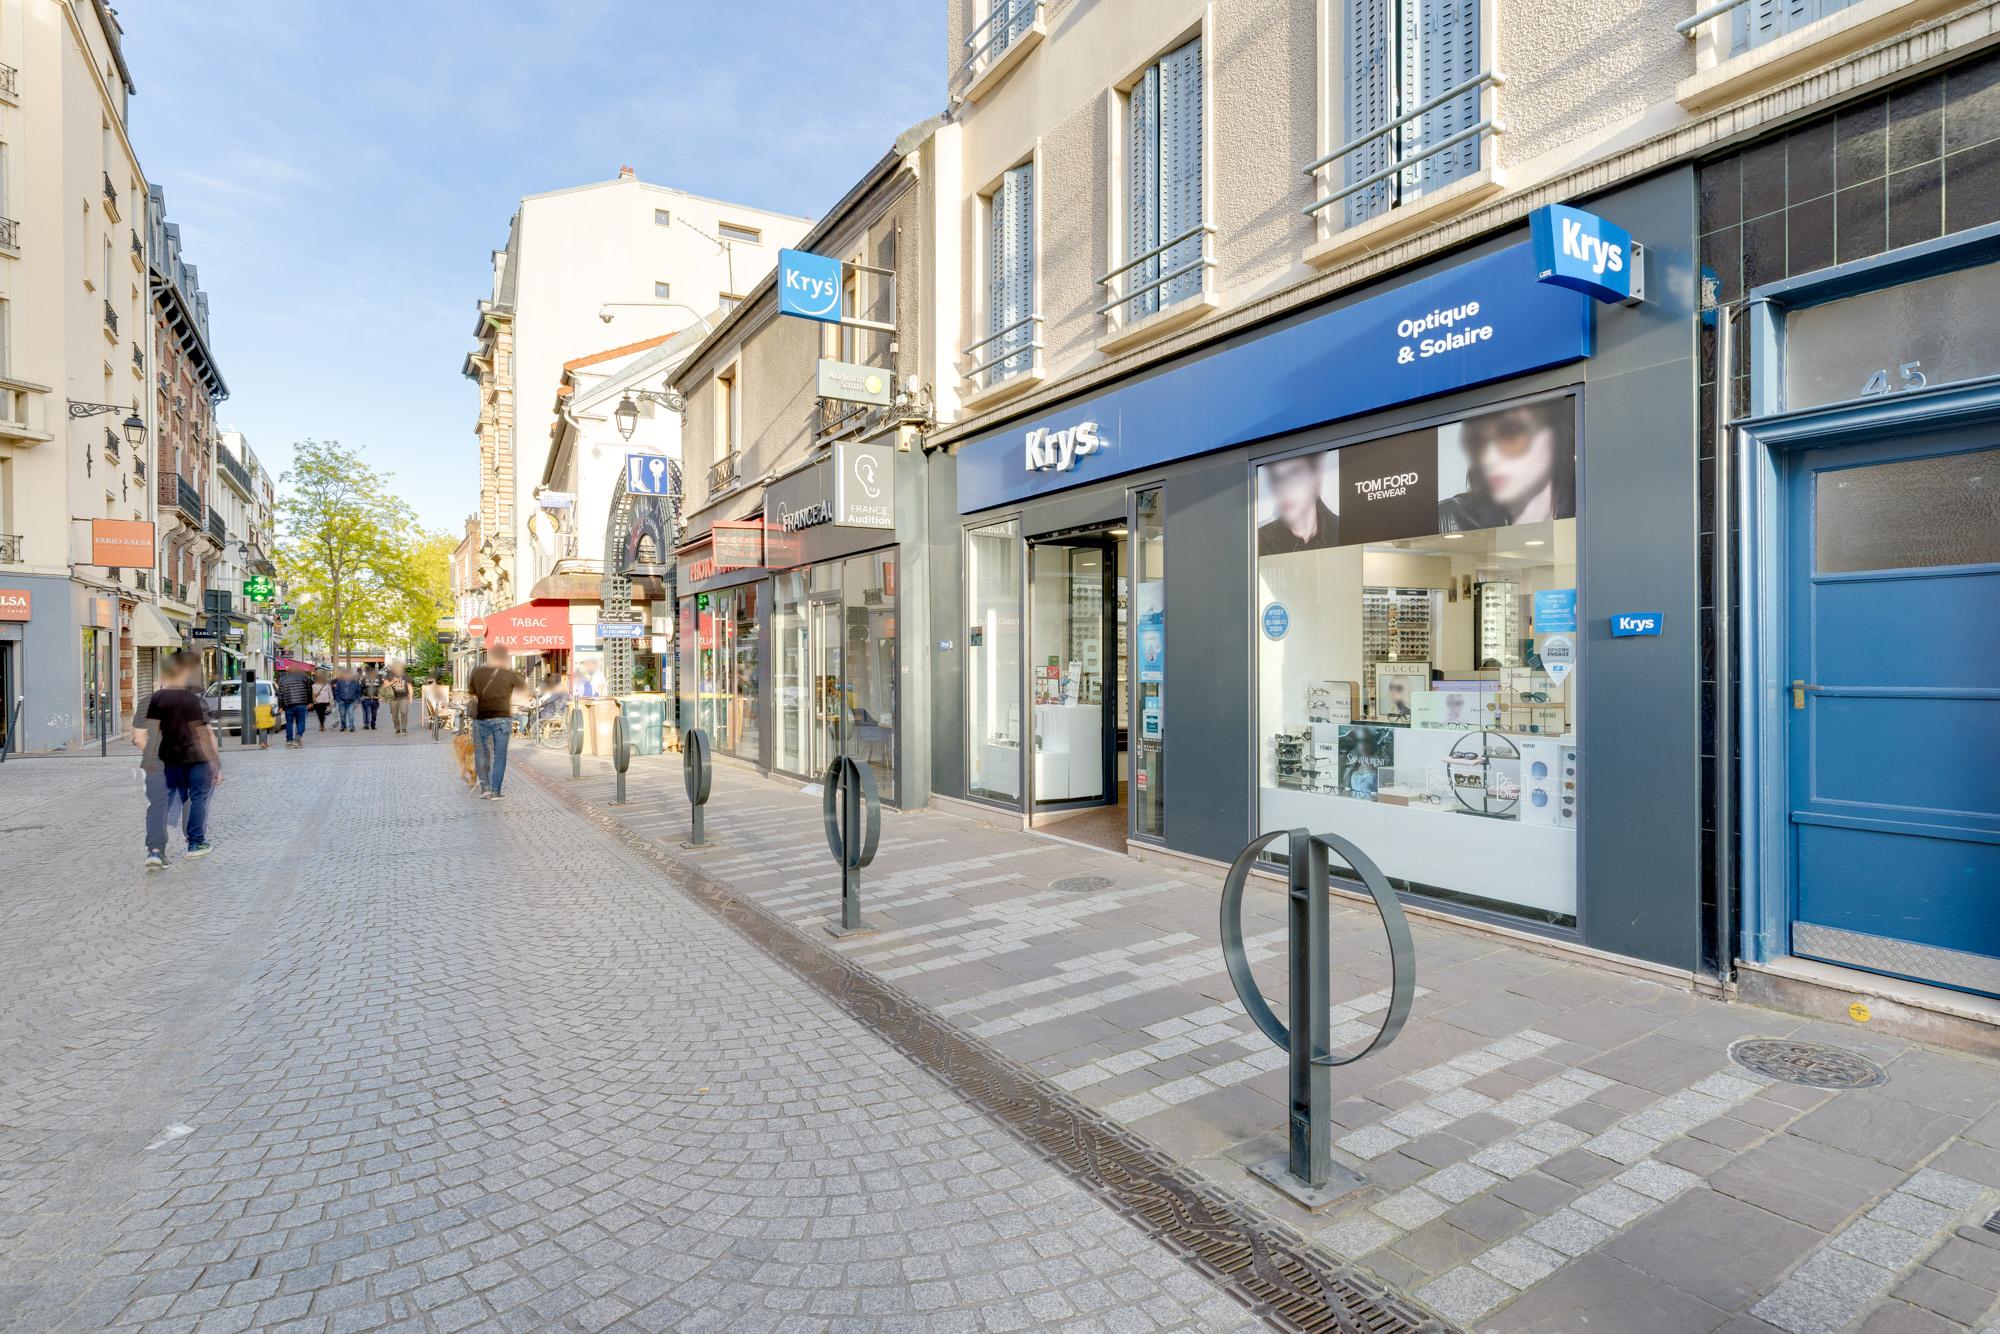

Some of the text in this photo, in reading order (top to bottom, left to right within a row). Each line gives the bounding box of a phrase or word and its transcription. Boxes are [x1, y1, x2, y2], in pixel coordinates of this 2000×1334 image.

[1562, 218, 1623, 274] Krys
[786, 268, 834, 299] Krys
[1397, 301, 1480, 338] Optique
[1397, 325, 1493, 364] & Solaire
[1025, 421, 1100, 472] Krys
[1355, 472, 1418, 494] TOM FORD
[1367, 487, 1406, 501] EYEWEAR
[783, 504, 821, 532] FRANCE
[850, 504, 888, 515] FRANCE
[847, 514, 891, 525] Audition
[510, 617, 548, 628] TABAC
[1620, 617, 1654, 632] Krys
[494, 636, 566, 645] AUX SPORTS
[1384, 665, 1421, 673] GUCCI
